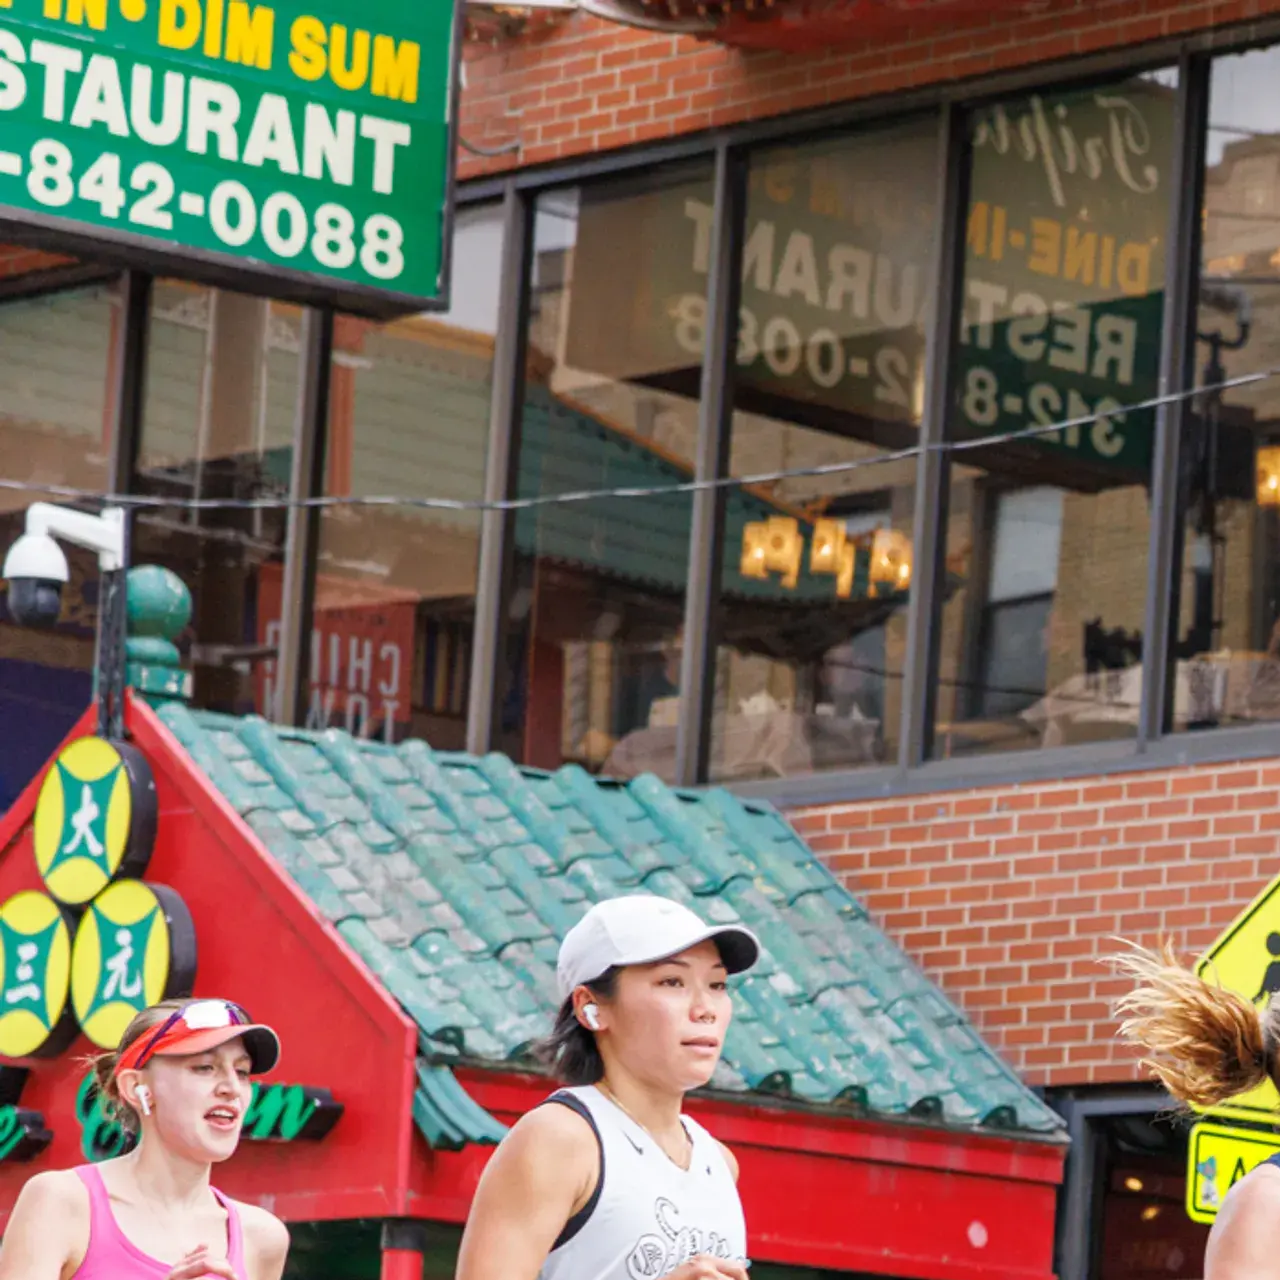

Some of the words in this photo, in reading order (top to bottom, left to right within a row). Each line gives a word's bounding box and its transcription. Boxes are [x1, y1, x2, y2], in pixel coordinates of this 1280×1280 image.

[158, 0, 275, 70] DIM
[288, 15, 420, 103] SUM
[63, 784, 105, 856] 大
[5, 942, 41, 1003] 三
[103, 929, 143, 1001] 元
